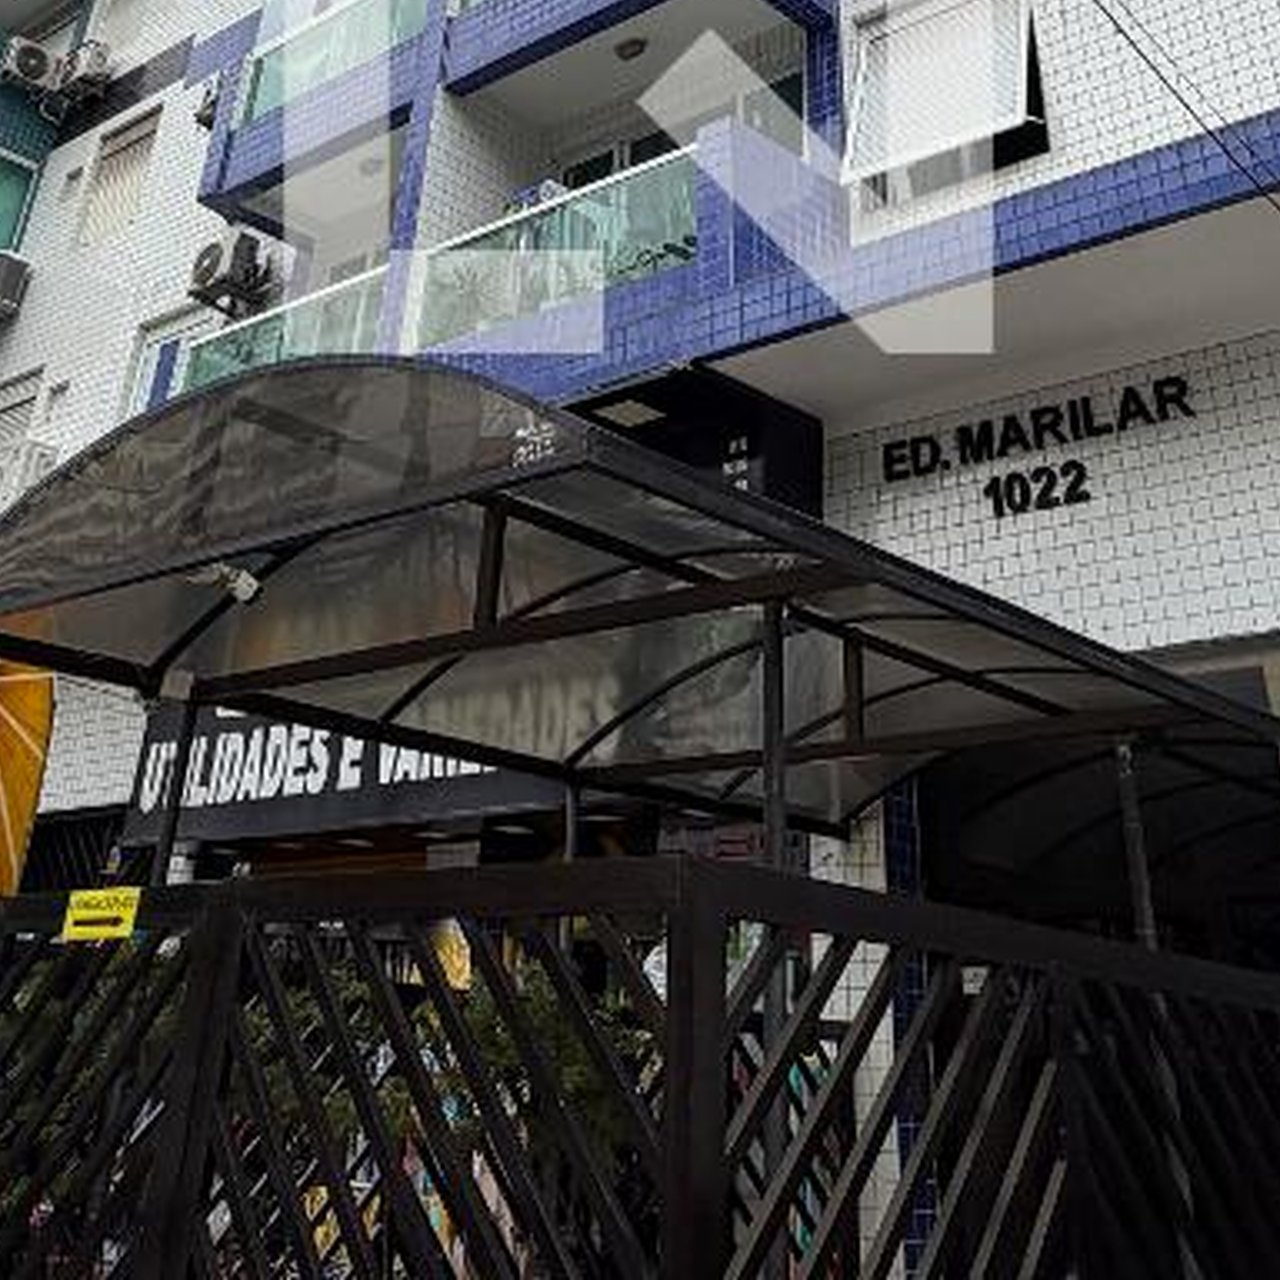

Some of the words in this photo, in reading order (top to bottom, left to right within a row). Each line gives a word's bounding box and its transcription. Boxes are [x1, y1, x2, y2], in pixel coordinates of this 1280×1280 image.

[881, 437, 951, 484] ED.
[958, 375, 1197, 466] MARILAR
[982, 459, 1091, 519] 1022
